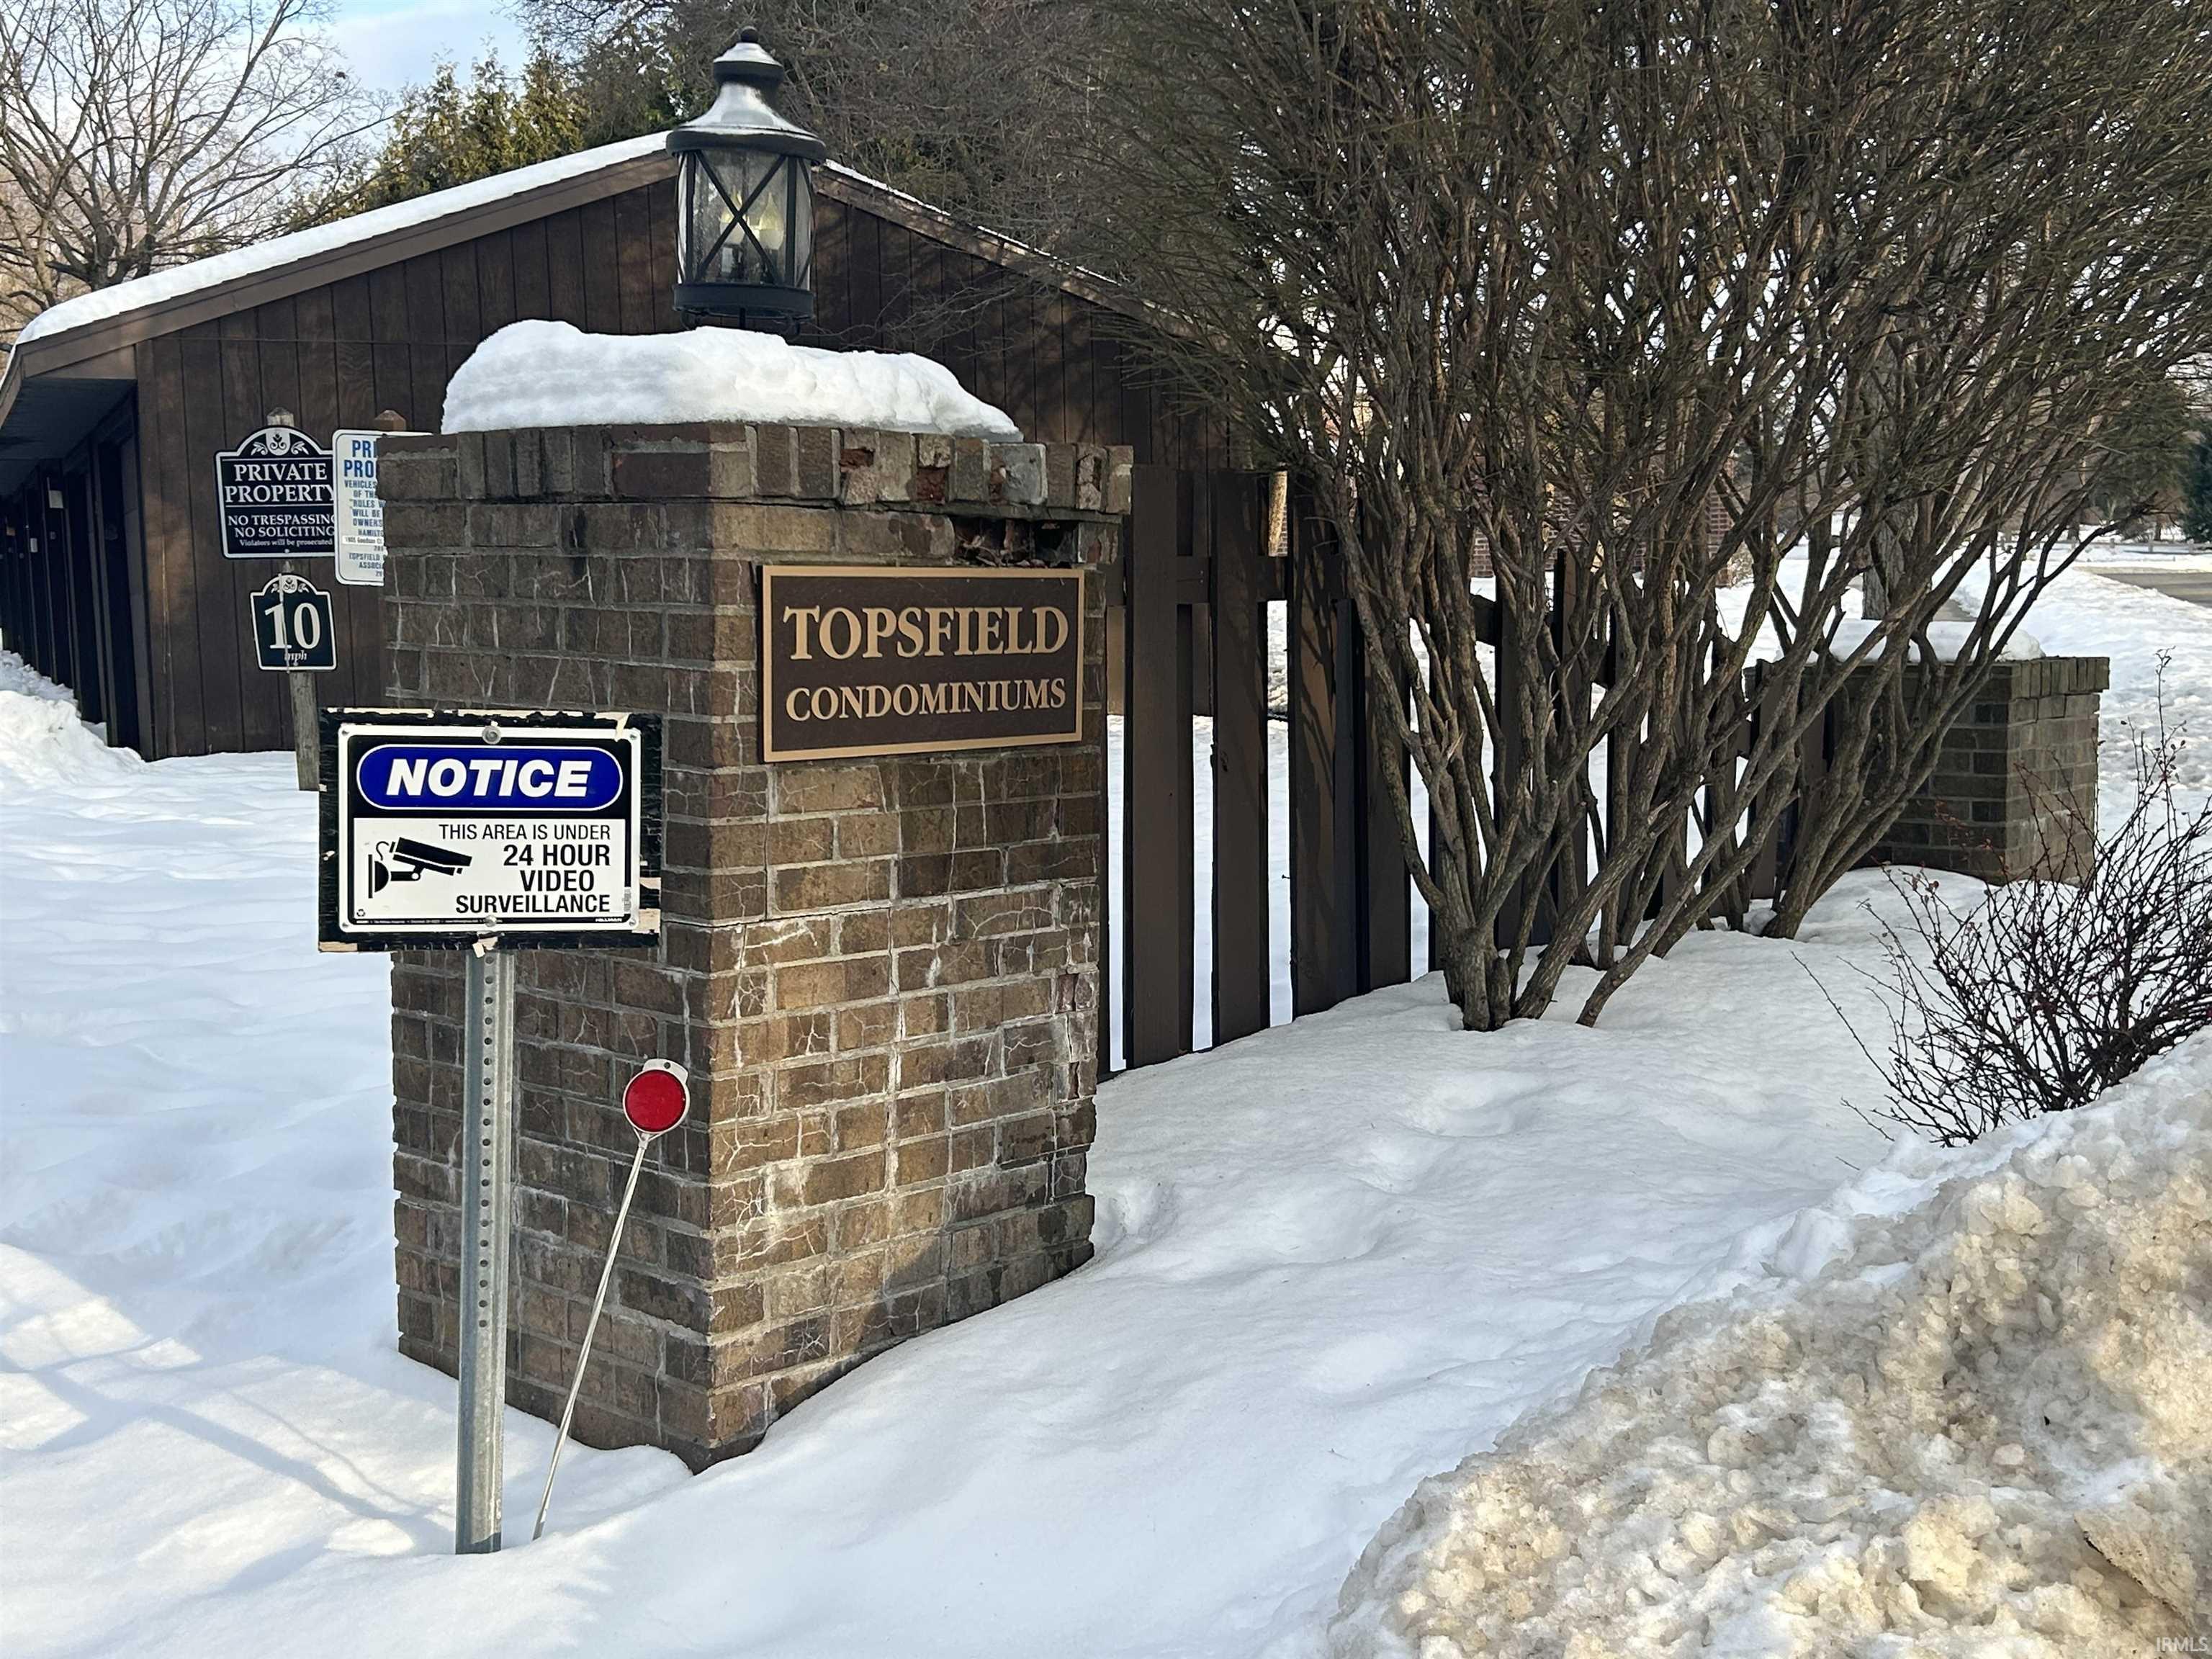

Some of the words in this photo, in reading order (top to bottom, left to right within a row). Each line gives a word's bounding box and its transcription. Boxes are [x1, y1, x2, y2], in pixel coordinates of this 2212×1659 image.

[234, 463, 328, 482] PRIVATE
[228, 515, 248, 526] NO
[235, 527, 255, 538] NO
[258, 526, 335, 537] SOLICITING
[297, 539, 333, 547] prosecuted
[265, 602, 321, 649] 10
[783, 605, 1069, 660] TOPSFIELD
[284, 649, 307, 664] mph
[786, 678, 1066, 721] CONDOMINIUMS
[386, 758, 592, 798] NOTICE
[439, 824, 477, 840] THIS
[482, 824, 526, 840] AREA
[533, 824, 548, 840] IS
[554, 824, 611, 840] UNDER
[503, 844, 534, 866] 24
[542, 845, 611, 866] HOUR
[520, 870, 595, 892] VIDEO
[456, 894, 610, 913] SURVEILLANCE
